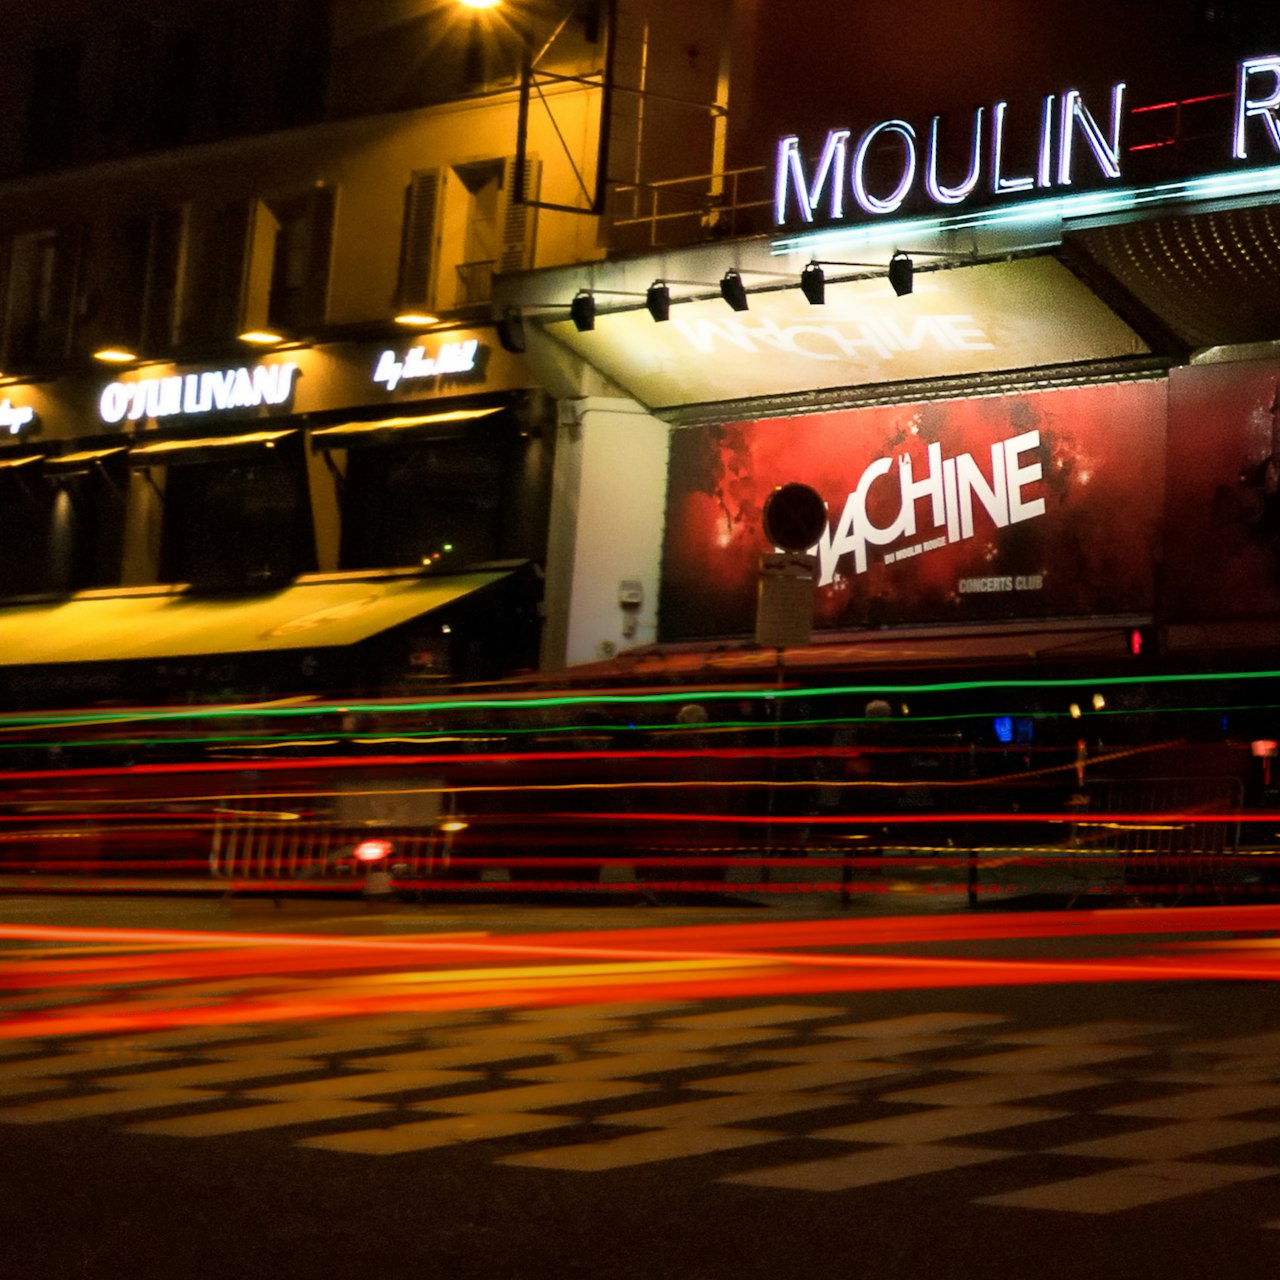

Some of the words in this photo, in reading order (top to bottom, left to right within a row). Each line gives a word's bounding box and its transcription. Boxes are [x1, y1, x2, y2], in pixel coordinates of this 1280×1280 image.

[773, 82, 1127, 225] MOULIN
[958, 577, 1013, 594] CONCERTS
[1014, 575, 1044, 591] CLUB
